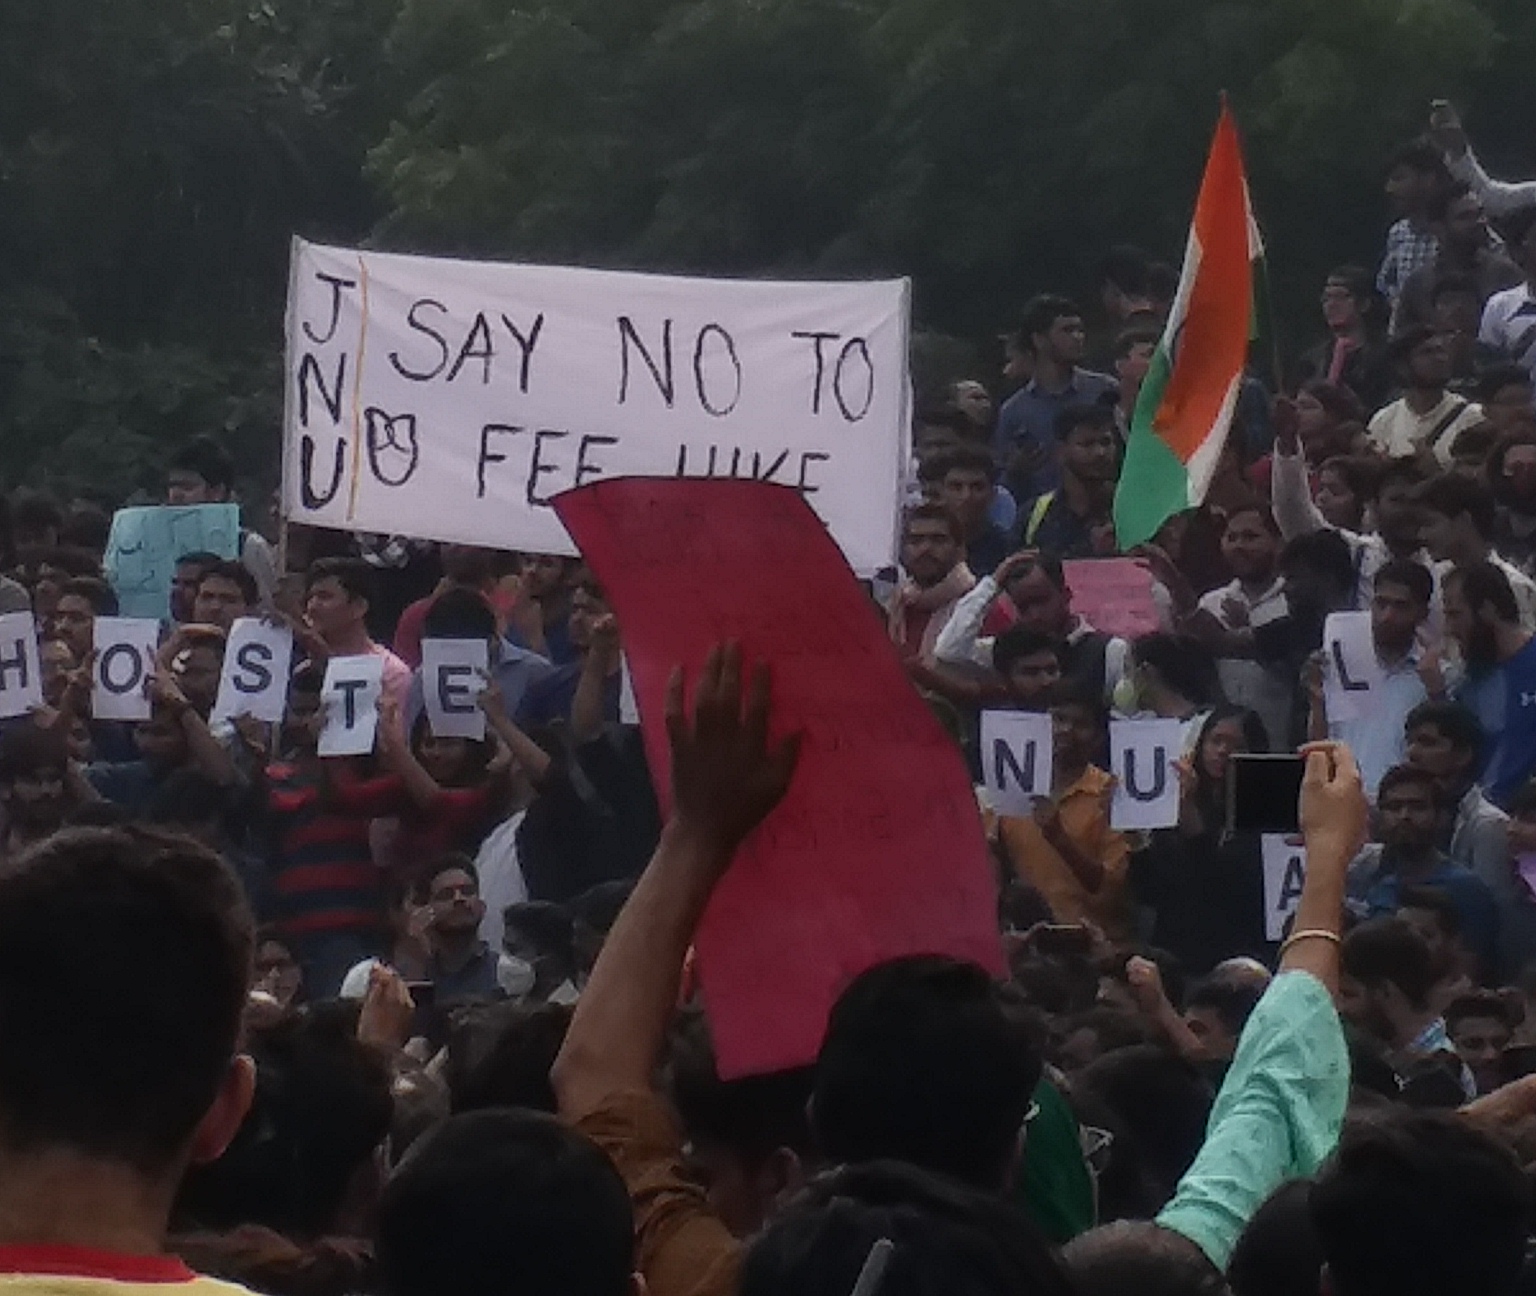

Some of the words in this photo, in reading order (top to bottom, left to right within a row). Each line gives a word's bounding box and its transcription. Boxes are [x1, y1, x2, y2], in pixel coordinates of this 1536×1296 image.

[388, 298, 545, 394] SAY
[618, 316, 743, 417] NO
[791, 330, 875, 423] TO
[477, 423, 619, 507] FEE
[232, 642, 273, 694] S
[437, 664, 476, 714] E
[1331, 639, 1370, 691] L
[333, 679, 368, 730] T
[993, 738, 1037, 793] N
[1123, 746, 1166, 802] U
